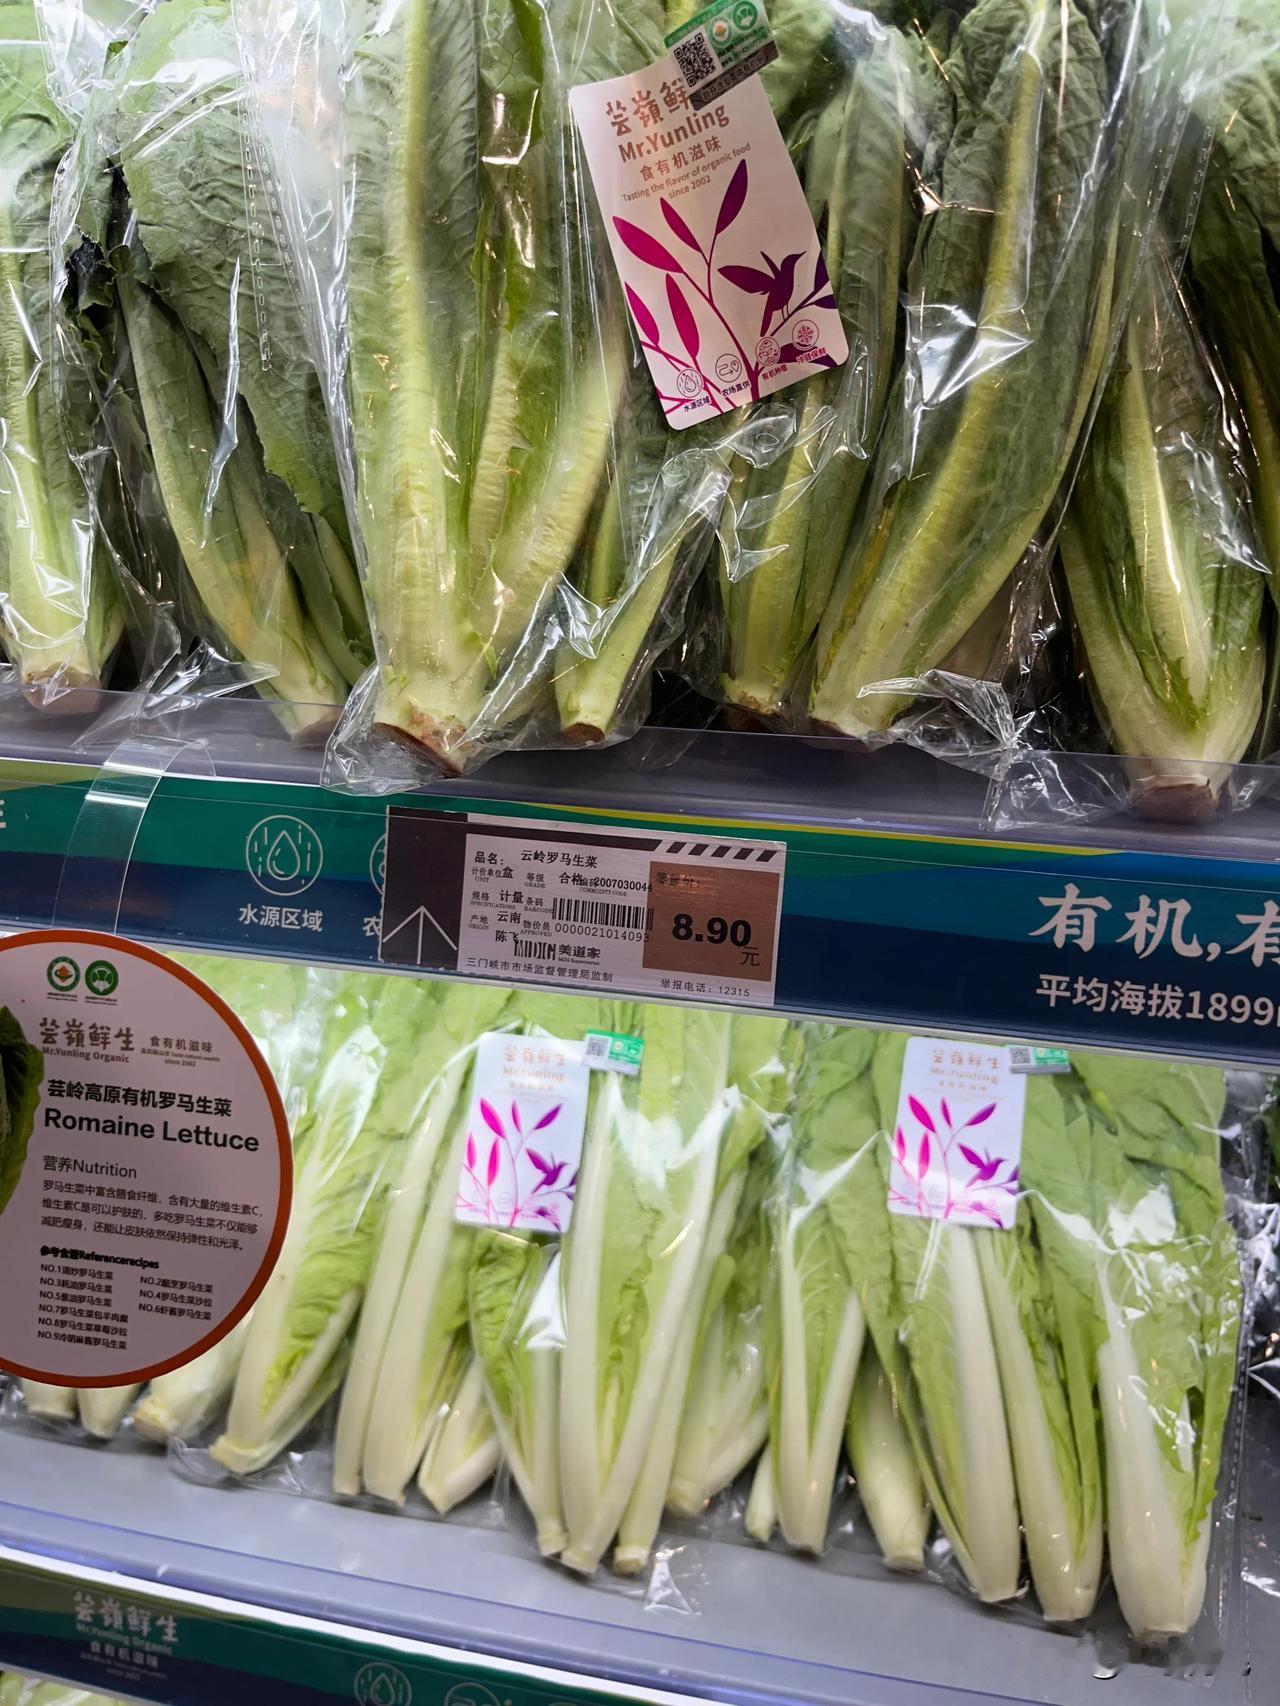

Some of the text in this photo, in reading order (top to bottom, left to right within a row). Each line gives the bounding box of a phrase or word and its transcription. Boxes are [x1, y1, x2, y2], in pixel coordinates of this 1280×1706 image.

[618, 105, 730, 163] Mr.Yunling
[640, 136, 722, 182] 食有机滋味
[622, 142, 751, 203] Tasting the flavor of organic food
[668, 175, 711, 199] since 2002
[721, 380, 750, 397] 农场直供
[683, 395, 711, 413] 水源区域
[474, 850, 598, 868] 品名: 云岭罗马生菜
[472, 866, 514, 879] 计价单位 盒
[526, 872, 545, 883] 等级
[559, 872, 583, 886] 合格
[524, 881, 546, 889] GRADE
[593, 876, 653, 893] 2007030044
[472, 890, 490, 902] 规格
[499, 890, 524, 904] 计量
[525, 897, 544, 907] 条码
[238, 903, 324, 932] 水源区域
[470, 914, 489, 925] 产地
[496, 910, 522, 925] 云南
[522, 919, 550, 931] 物价员
[520, 929, 553, 937] APPROVED
[672, 913, 752, 947] 8.90
[558, 944, 601, 959] 美道家
[740, 945, 760, 967] 元
[466, 957, 613, 982] 三门峡市市场监督管理局监制
[150, 1035, 213, 1054] 食有机滋味
[42, 1046, 91, 1062] Mr.Yunling
[93, 1051, 130, 1064] Organic
[47, 1079, 232, 1117] 芸岭高原有机罗马生菜
[44, 1107, 260, 1152] Romaine Lettuce
